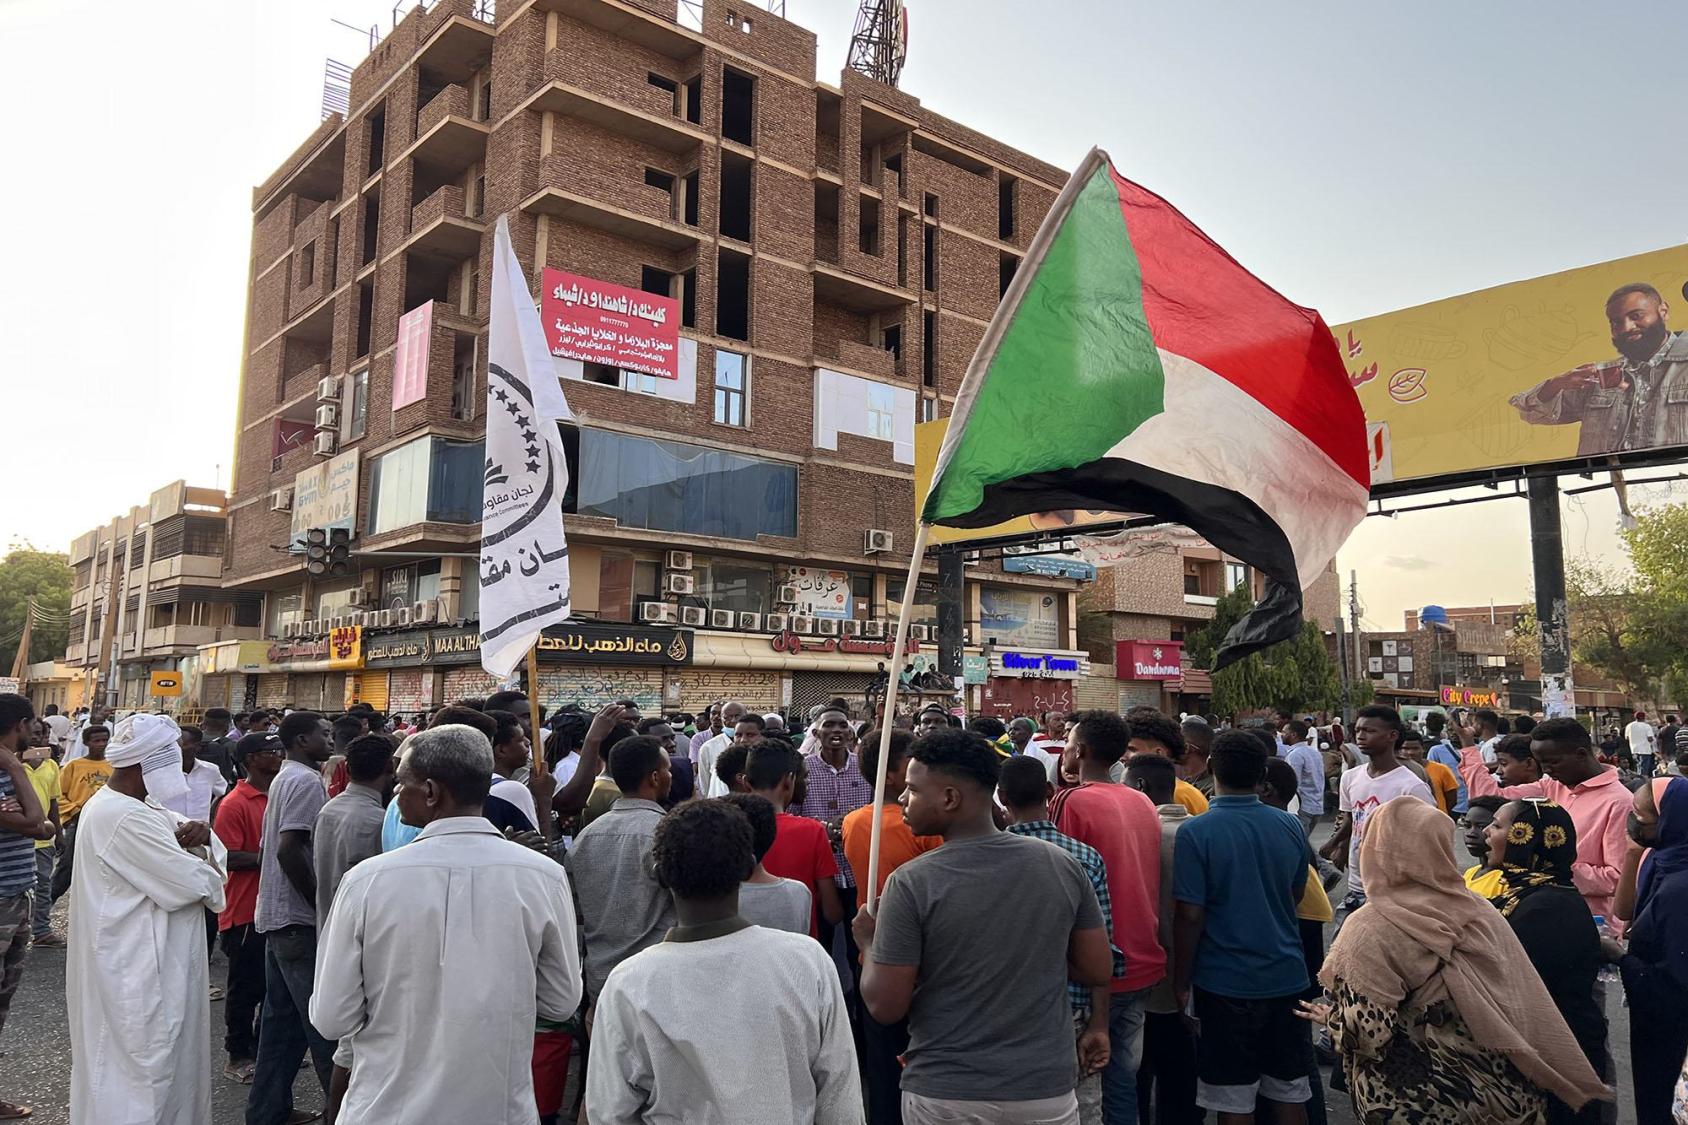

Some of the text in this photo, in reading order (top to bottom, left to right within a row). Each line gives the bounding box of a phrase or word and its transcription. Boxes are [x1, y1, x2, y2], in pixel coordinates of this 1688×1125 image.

[555, 317, 590, 337] الجذعية
[592, 326, 617, 341] الخلايا
[625, 333, 650, 351] البلازما
[651, 336, 673, 352] معجزة
[298, 490, 318, 508] GYM
[511, 484, 534, 502] لجان
[798, 575, 839, 599] عرفات
[406, 644, 418, 657] ماء
[435, 637, 453, 654] MAA
[537, 632, 583, 652] للعط
[584, 636, 635, 654] الذهب
[634, 639, 662, 653] ماء
[1002, 652, 1077, 671] Silver Town
[721, 671, 731, 687] 6
[1442, 688, 1490, 708] City Crepe
